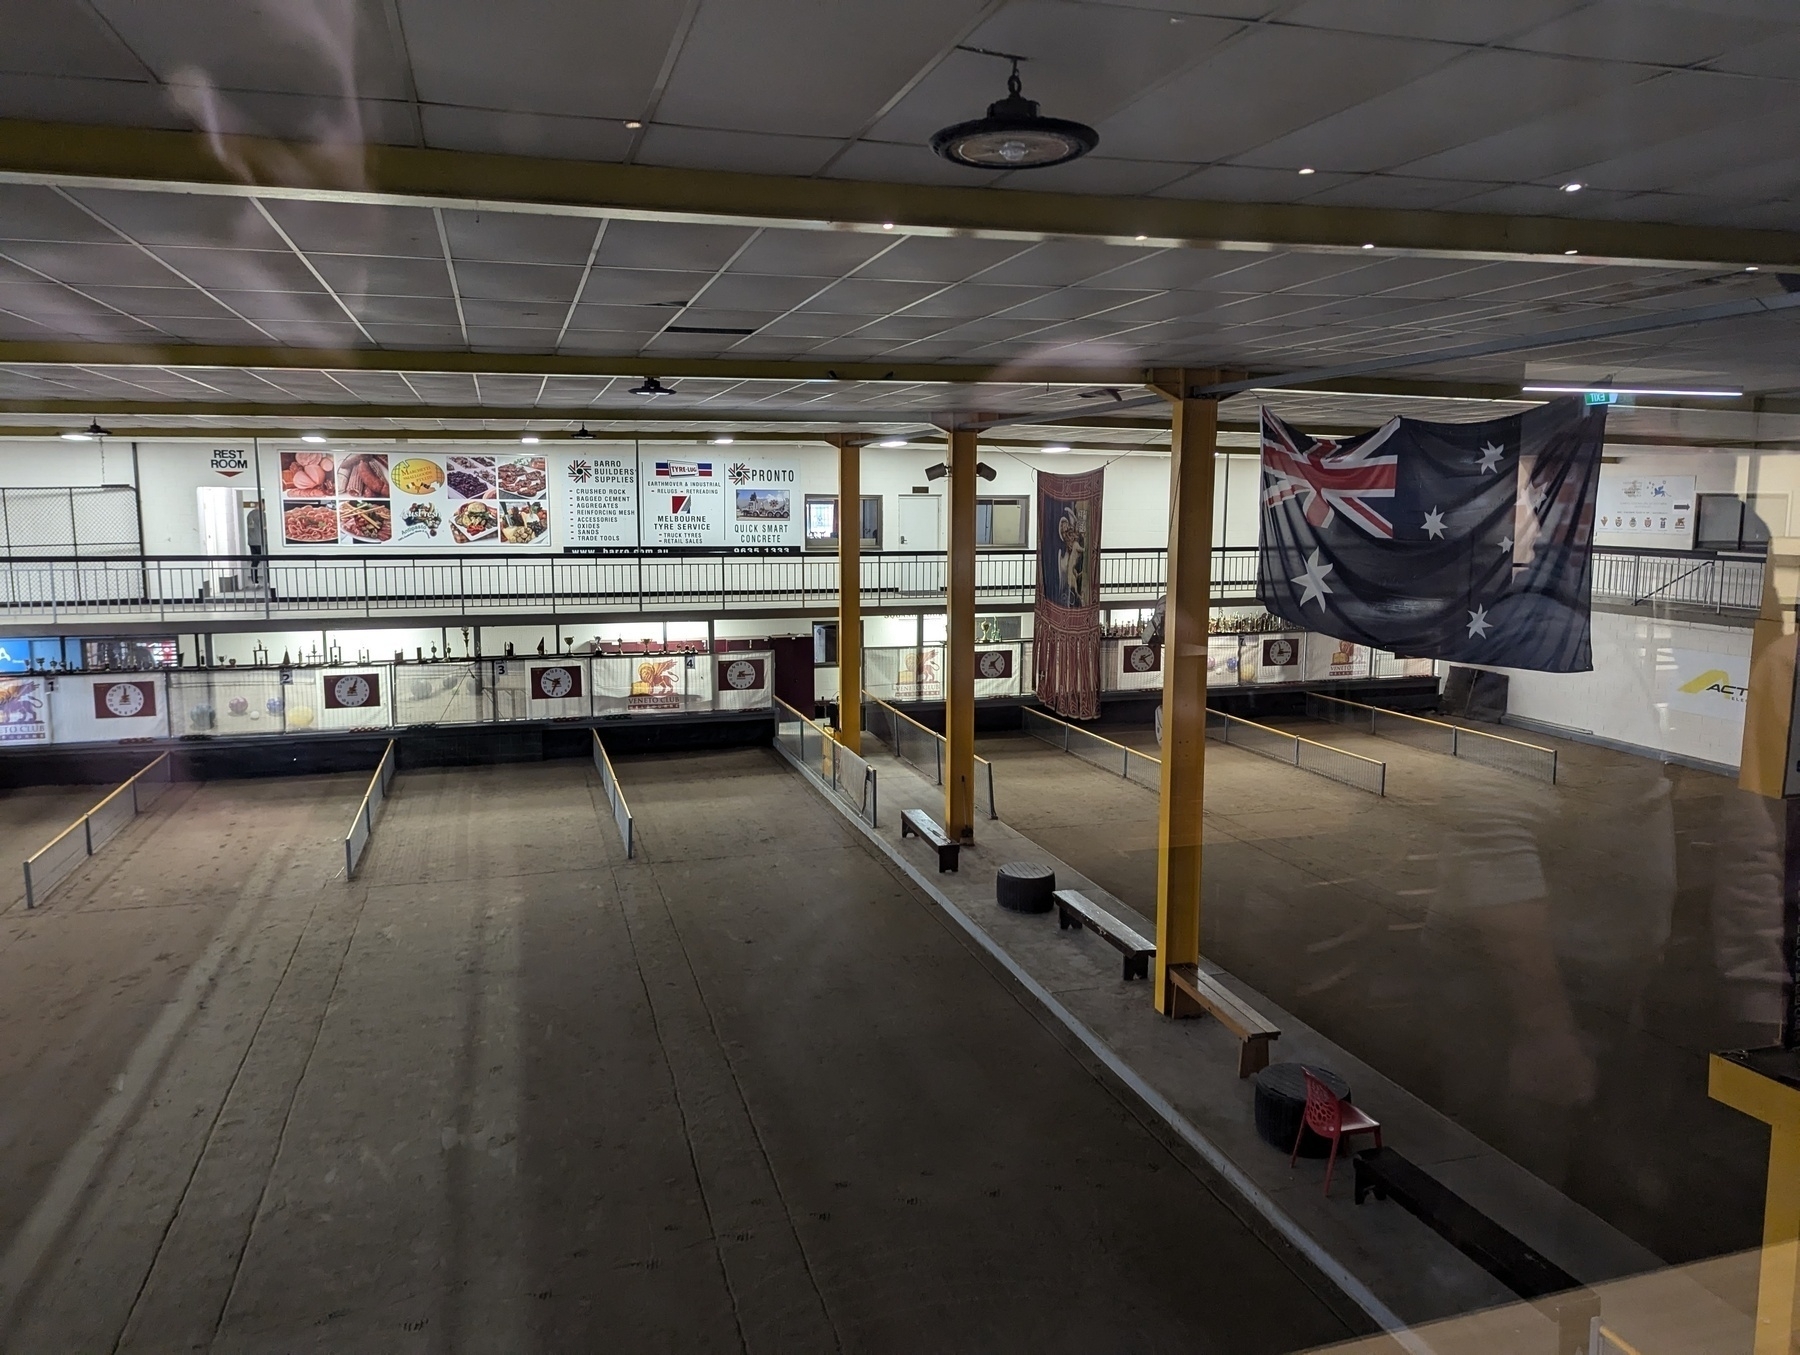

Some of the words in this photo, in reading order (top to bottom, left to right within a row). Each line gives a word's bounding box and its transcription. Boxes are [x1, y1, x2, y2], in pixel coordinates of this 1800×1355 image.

[213, 449, 245, 459] REST
[210, 459, 248, 469] ROOM
[594, 460, 621, 468] BARRO
[671, 465, 698, 473] TYRE-LUG
[751, 469, 794, 482] PRONTO
[401, 525, 427, 535] Antipasto
[734, 524, 759, 533] QUICK
[761, 524, 789, 533] SMART
[740, 534, 781, 543] CONCRETE
[686, 659, 693, 668] 4
[498, 665, 505, 675] 3
[282, 674, 290, 684] 2
[48, 682, 54, 691] 1
[1705, 683, 1748, 696] ACT
[628, 696, 658, 704] VENETO
